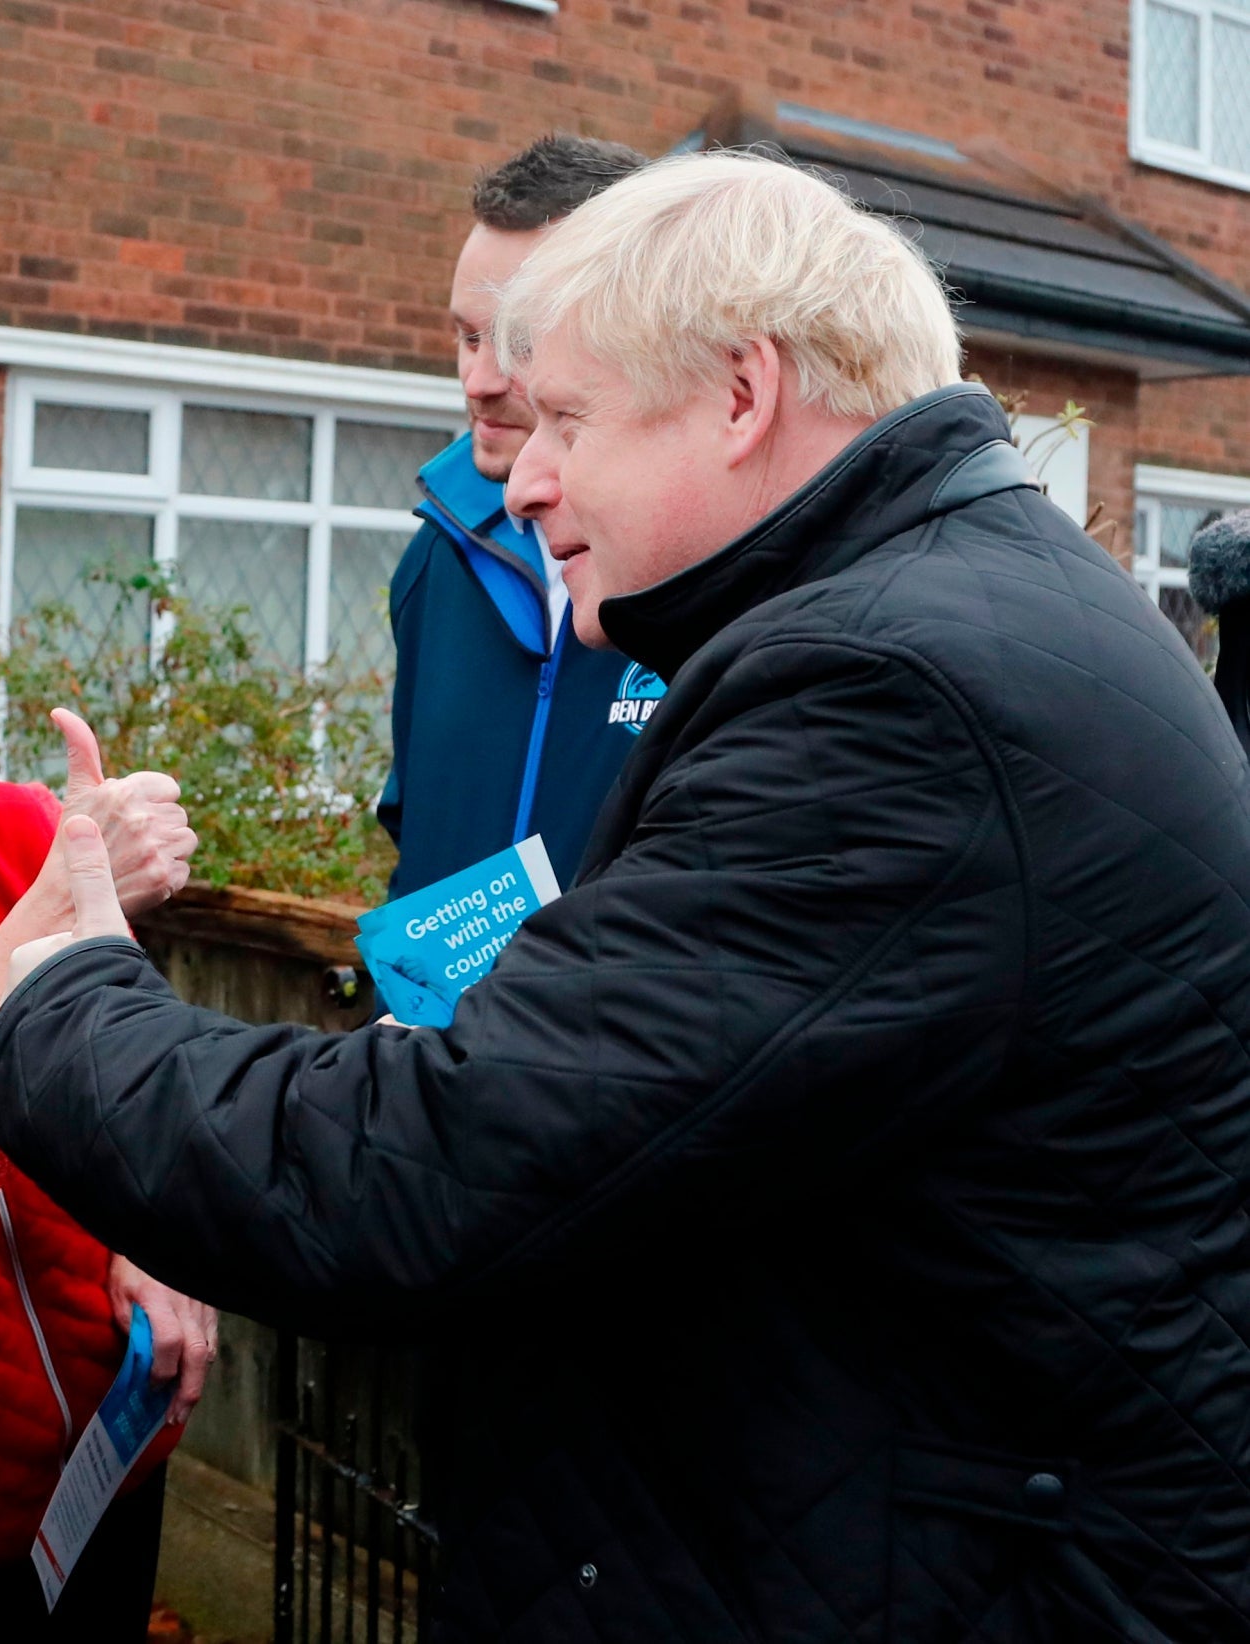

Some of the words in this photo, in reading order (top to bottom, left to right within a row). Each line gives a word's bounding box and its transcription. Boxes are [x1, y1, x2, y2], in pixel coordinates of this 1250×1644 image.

[608, 700, 641, 724] BEN
[406, 889, 488, 940] Getting
[490, 871, 517, 896] on
[444, 916, 491, 950] with
[491, 896, 527, 923] the
